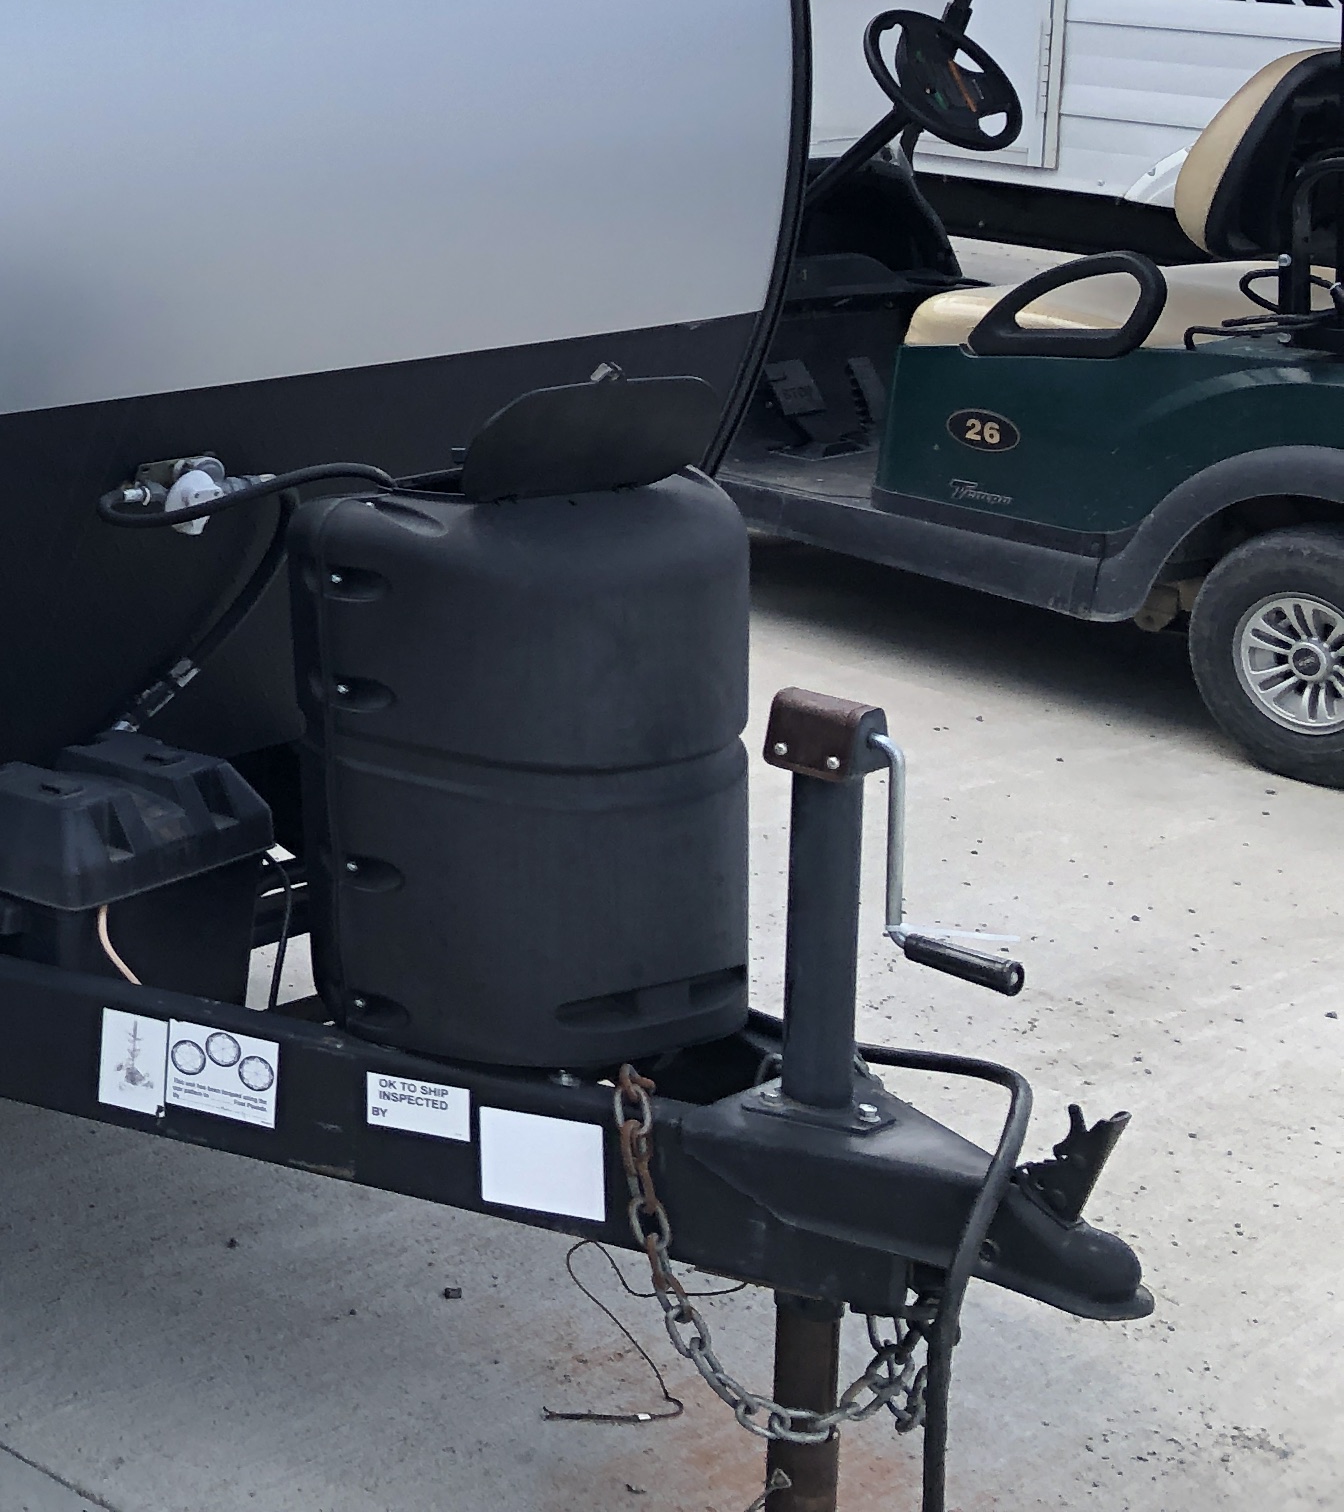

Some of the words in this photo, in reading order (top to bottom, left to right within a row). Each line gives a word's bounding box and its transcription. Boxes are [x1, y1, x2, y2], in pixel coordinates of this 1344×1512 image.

[965, 418, 1001, 444] 26
[379, 1079, 397, 1090] OK
[400, 1081, 417, 1093] TO
[420, 1086, 448, 1097] SHIP
[379, 1091, 448, 1110] INSPECTED
[372, 1106, 388, 1117] BY
